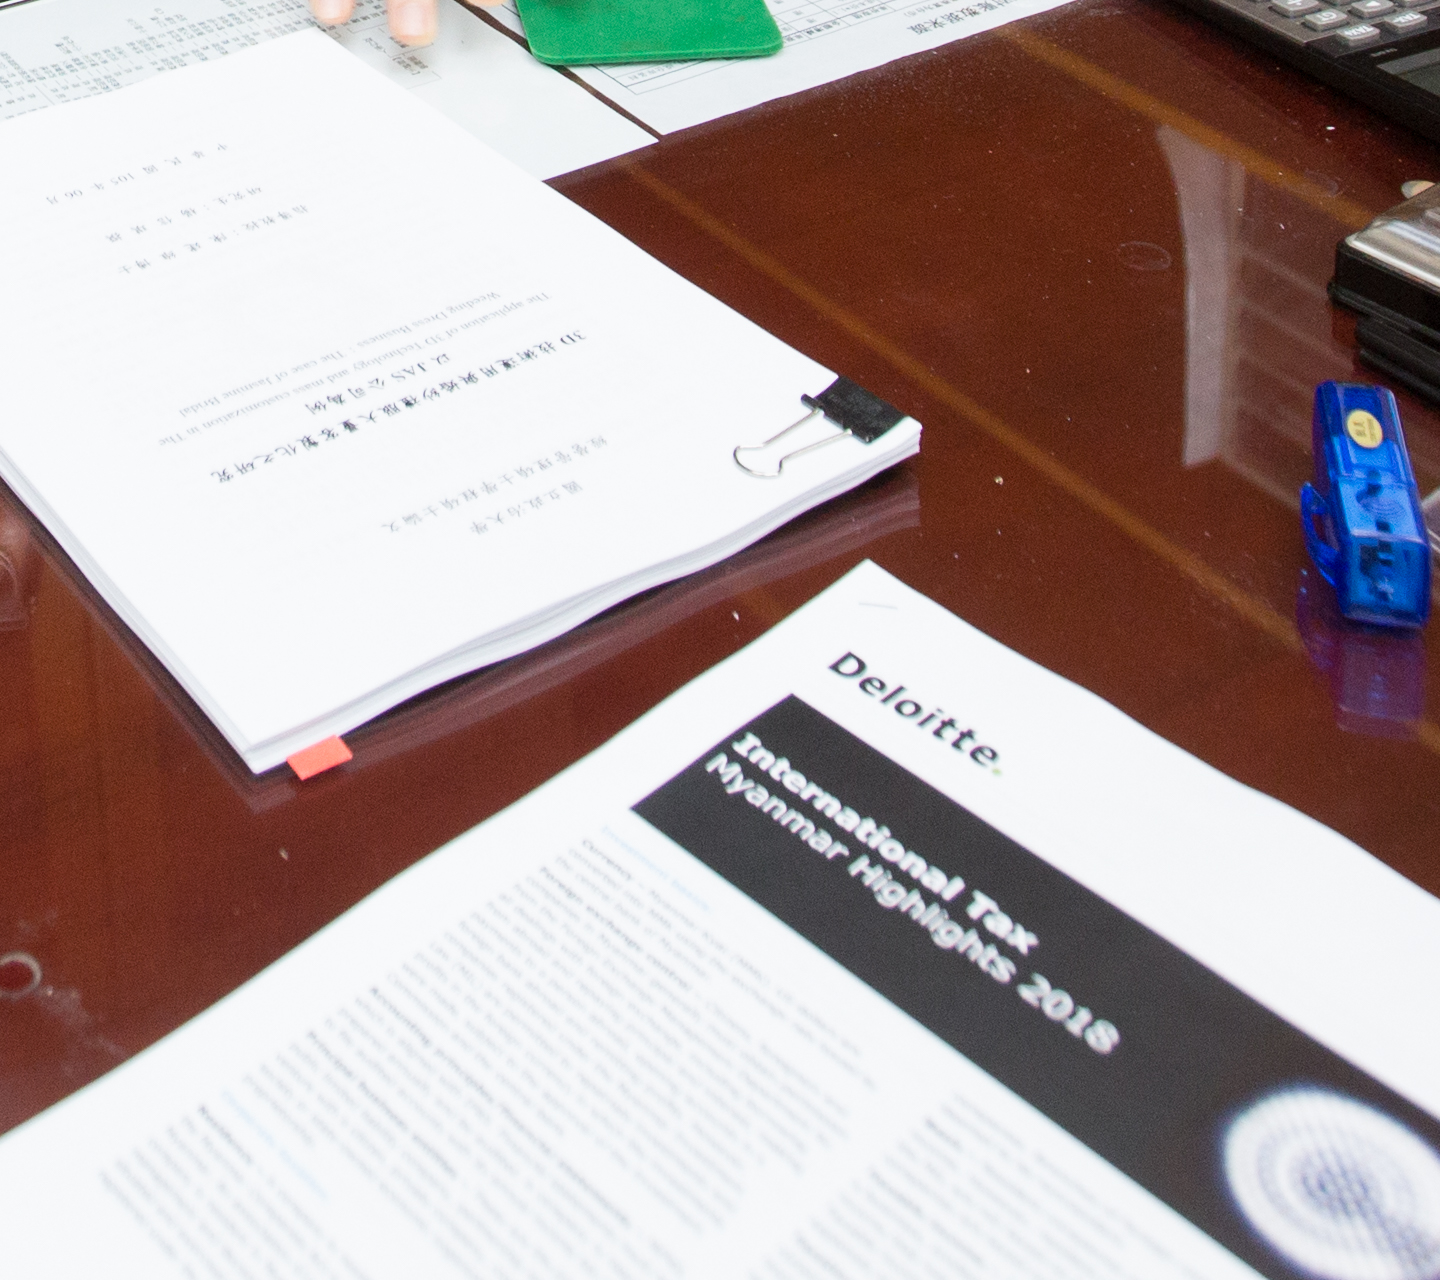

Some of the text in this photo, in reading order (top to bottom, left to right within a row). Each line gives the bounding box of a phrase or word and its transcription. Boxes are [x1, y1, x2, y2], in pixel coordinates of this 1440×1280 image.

[1316, 9, 1337, 22] GT
[110, 172, 135, 186] 105
[526, 291, 550, 304] The
[459, 300, 525, 330] application
[424, 334, 445, 346] 3D
[444, 327, 459, 339] of
[559, 332, 586, 345] 3D
[178, 291, 502, 418] Weeding Dress Business The case of Jasmine Bridal
[352, 341, 423, 371] Technology
[326, 368, 350, 384] and
[390, 362, 427, 381] JAS
[292, 378, 325, 394] mass
[201, 391, 291, 429] customization
[158, 432, 187, 446] The
[469, 479, 584, 536] 國立政治大學
[723, 724, 1047, 962] International Tax
[706, 753, 1128, 1063] Myanmar Highlights 2018
